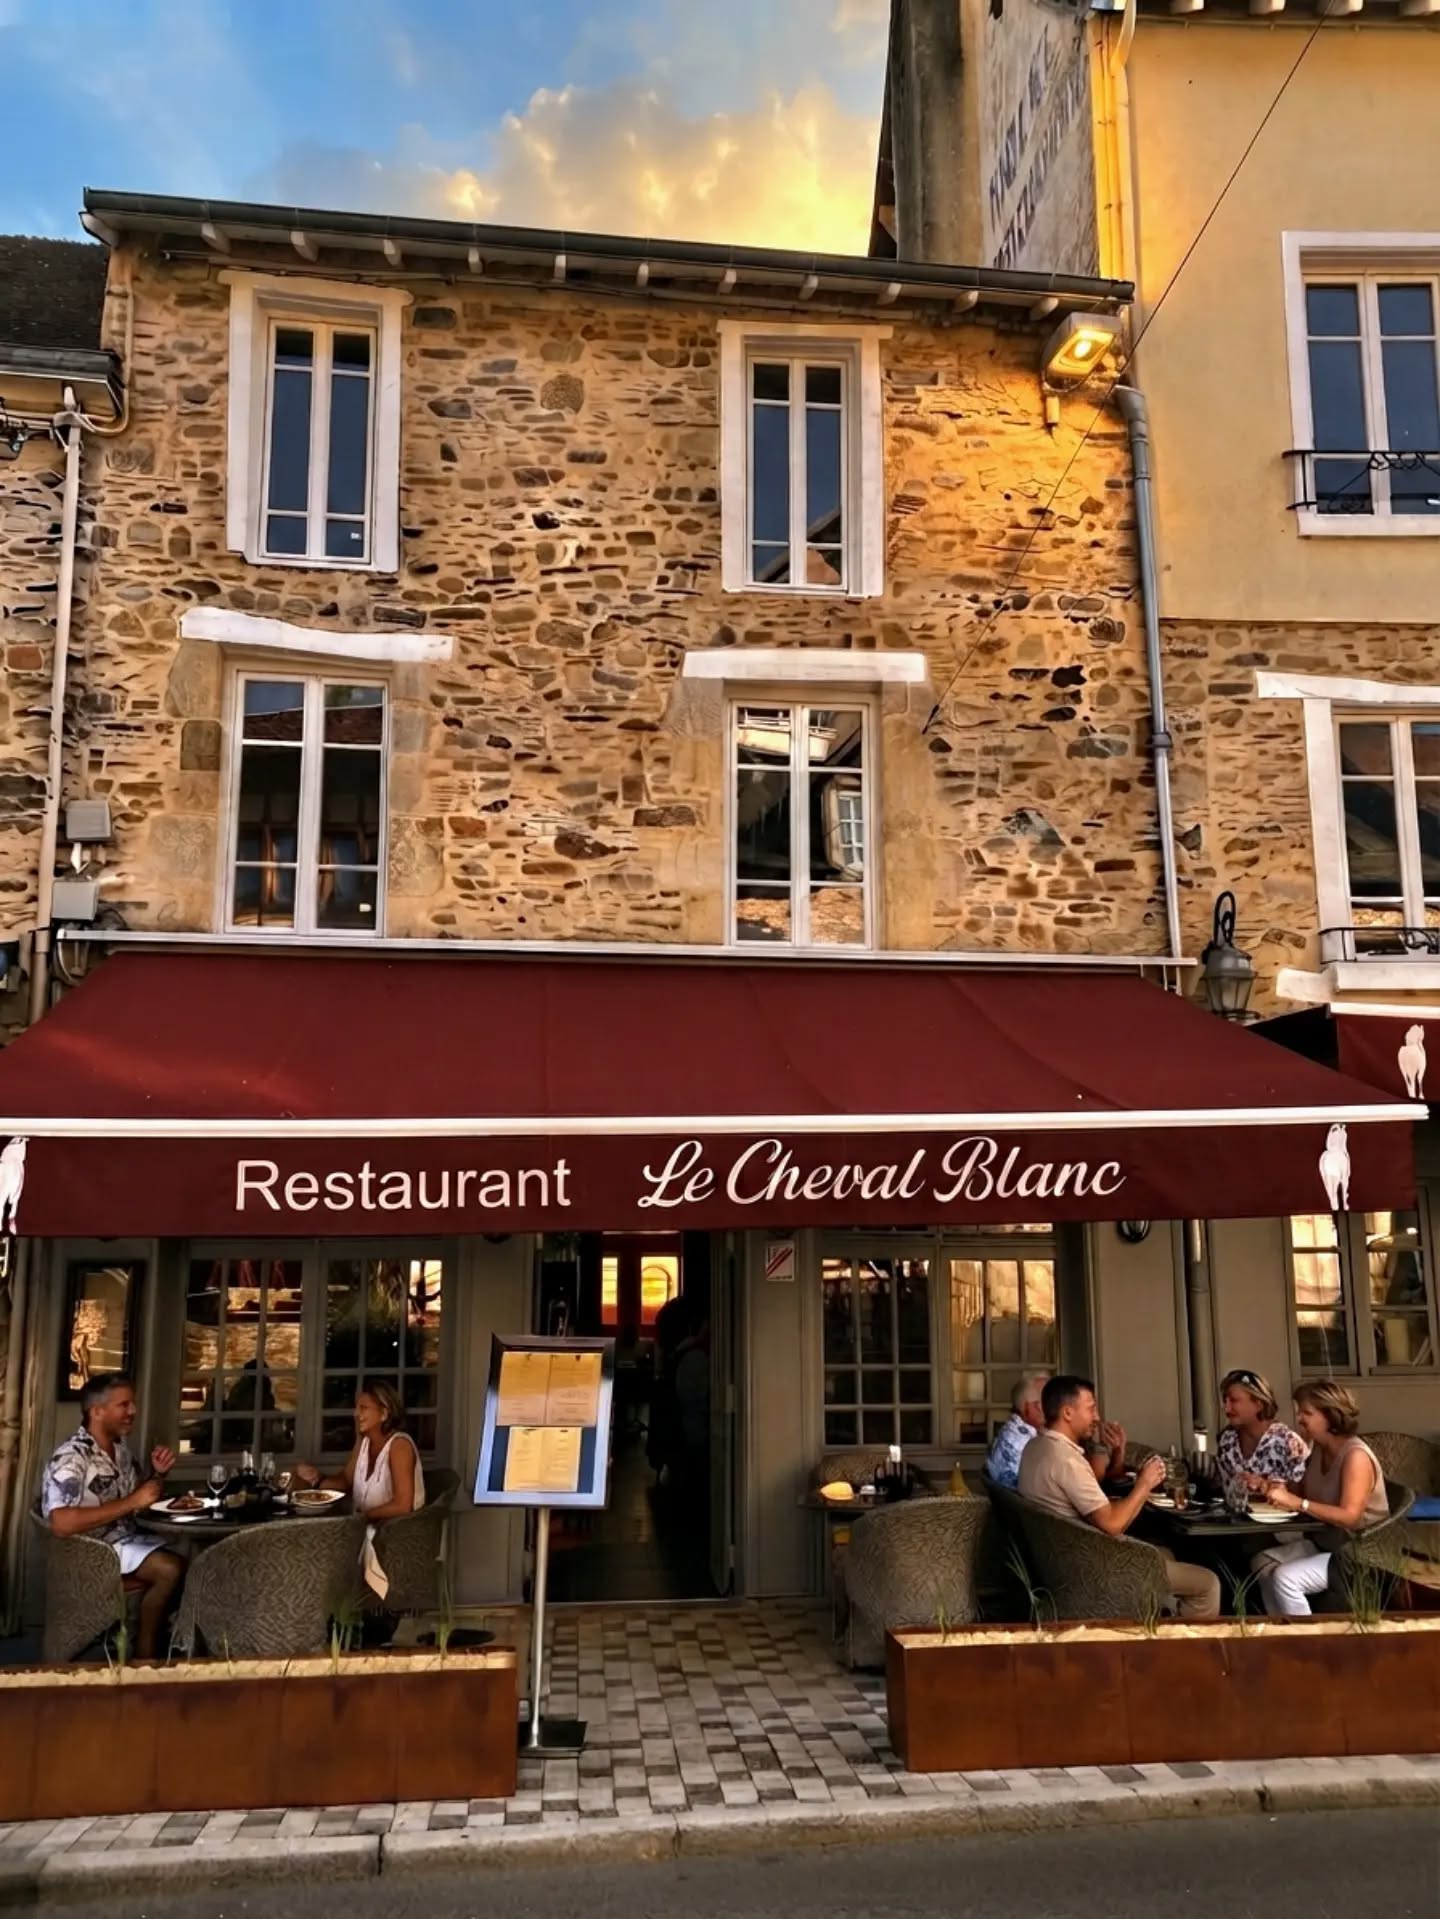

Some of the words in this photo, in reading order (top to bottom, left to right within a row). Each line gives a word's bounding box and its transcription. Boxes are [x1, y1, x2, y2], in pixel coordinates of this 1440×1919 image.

[236, 1159, 571, 1210] Restaurant
[638, 1140, 714, 1208] Le
[726, 1138, 926, 1204] Cheval
[934, 1136, 1127, 1202] Blanc
